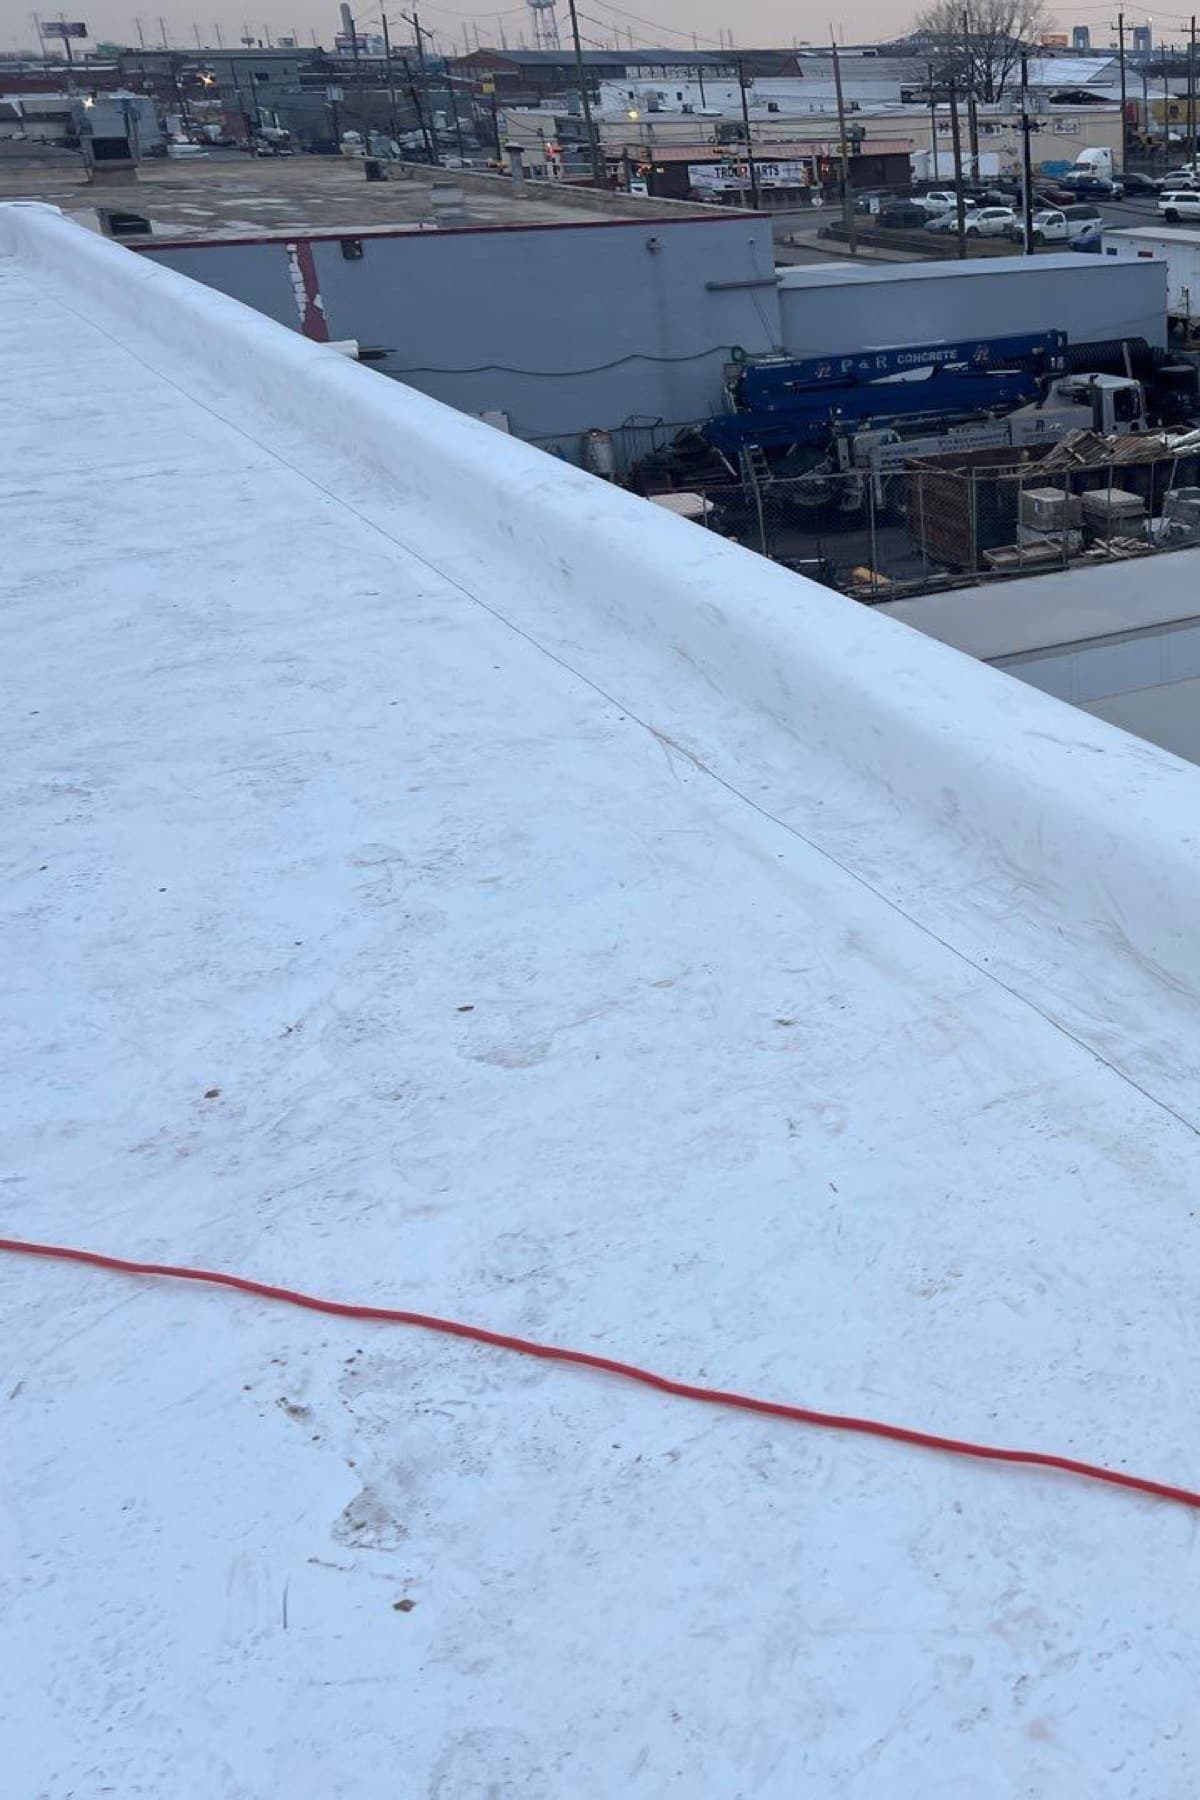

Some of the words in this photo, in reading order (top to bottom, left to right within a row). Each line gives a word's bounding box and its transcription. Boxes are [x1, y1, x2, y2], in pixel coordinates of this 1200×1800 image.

[714, 166, 747, 179] TRU
[748, 163, 780, 177] ARTS
[841, 359, 853, 373] P
[858, 360, 870, 369] &
[876, 355, 888, 369] R
[897, 349, 958, 364] CONCRETE
